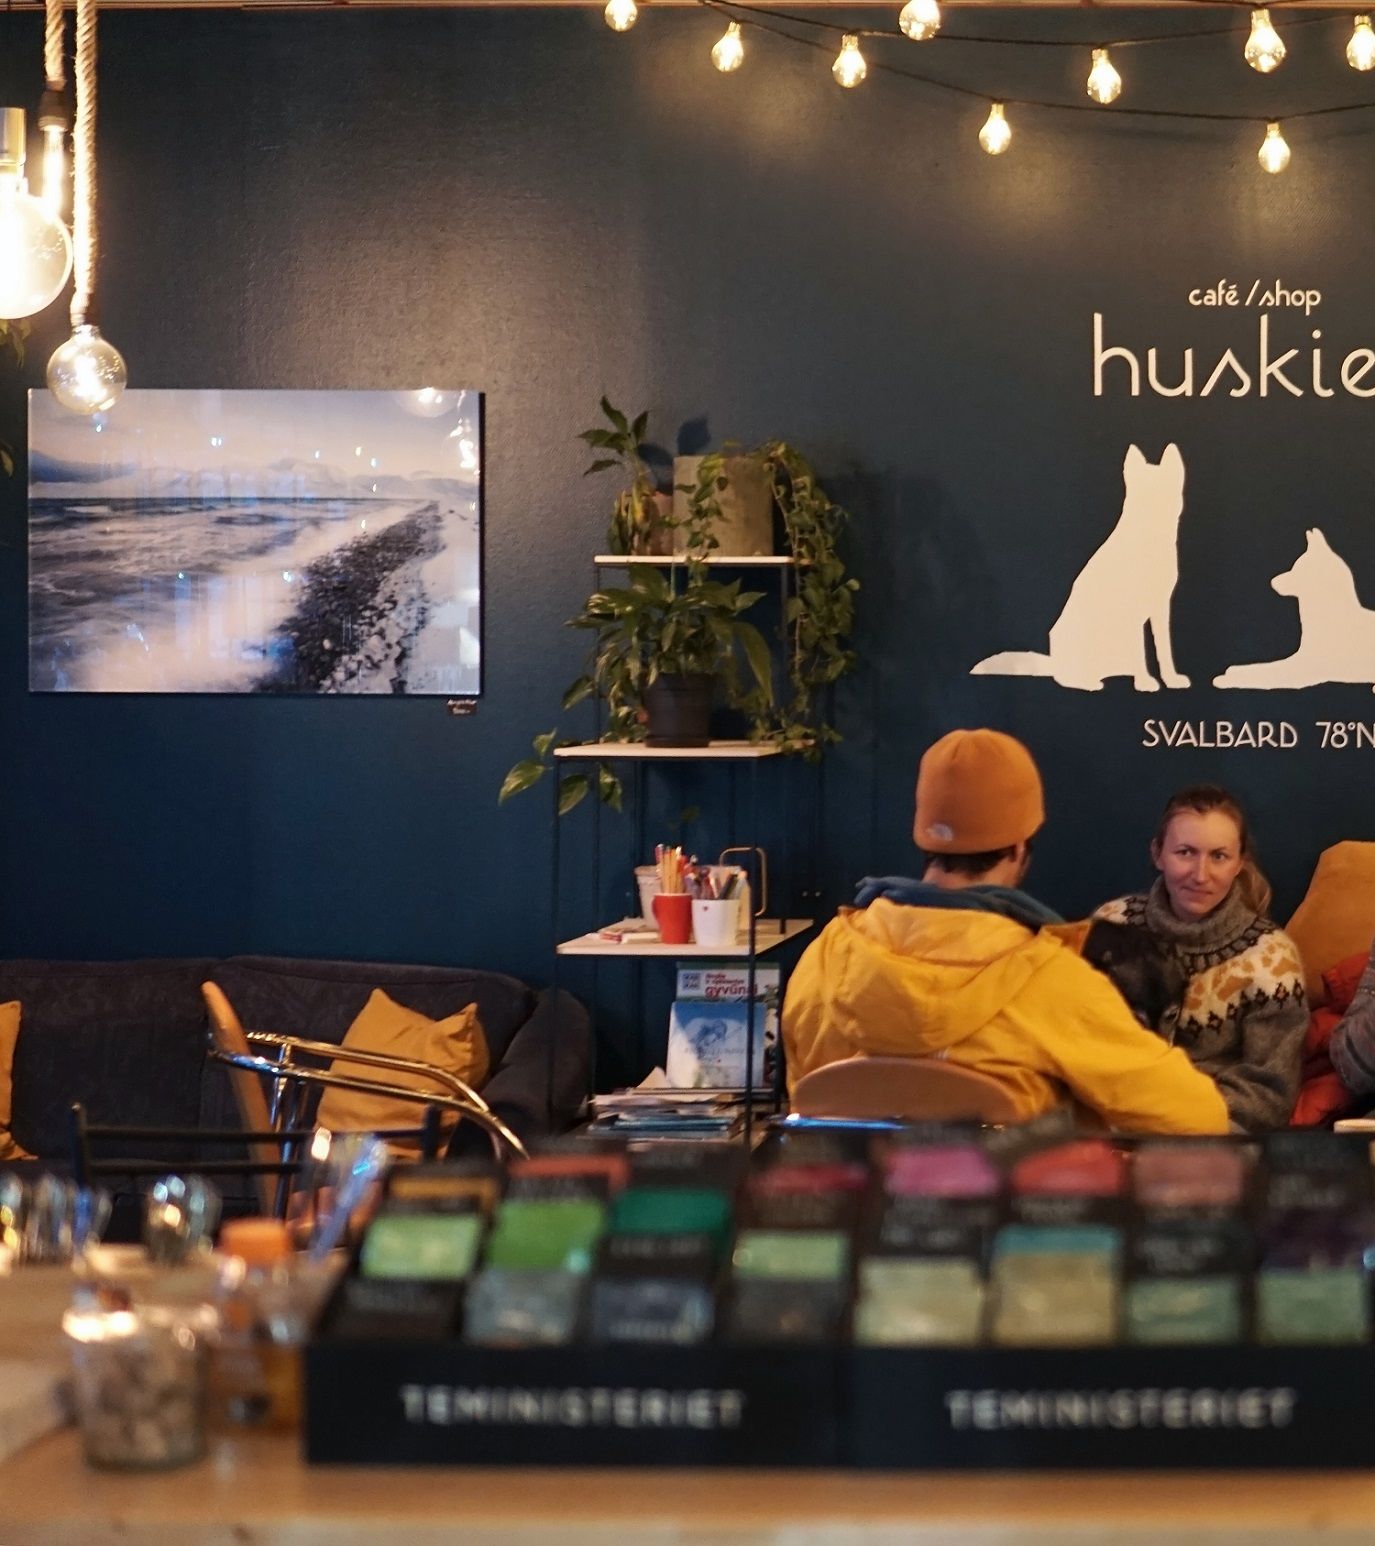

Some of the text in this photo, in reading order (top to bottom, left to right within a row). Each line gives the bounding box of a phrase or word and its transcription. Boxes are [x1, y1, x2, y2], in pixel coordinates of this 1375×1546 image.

[1142, 719, 1298, 748] SVALBARD
[401, 1385, 745, 1430] TEMINISTERIET
[945, 1388, 1298, 1431] TEMINISTERIET
